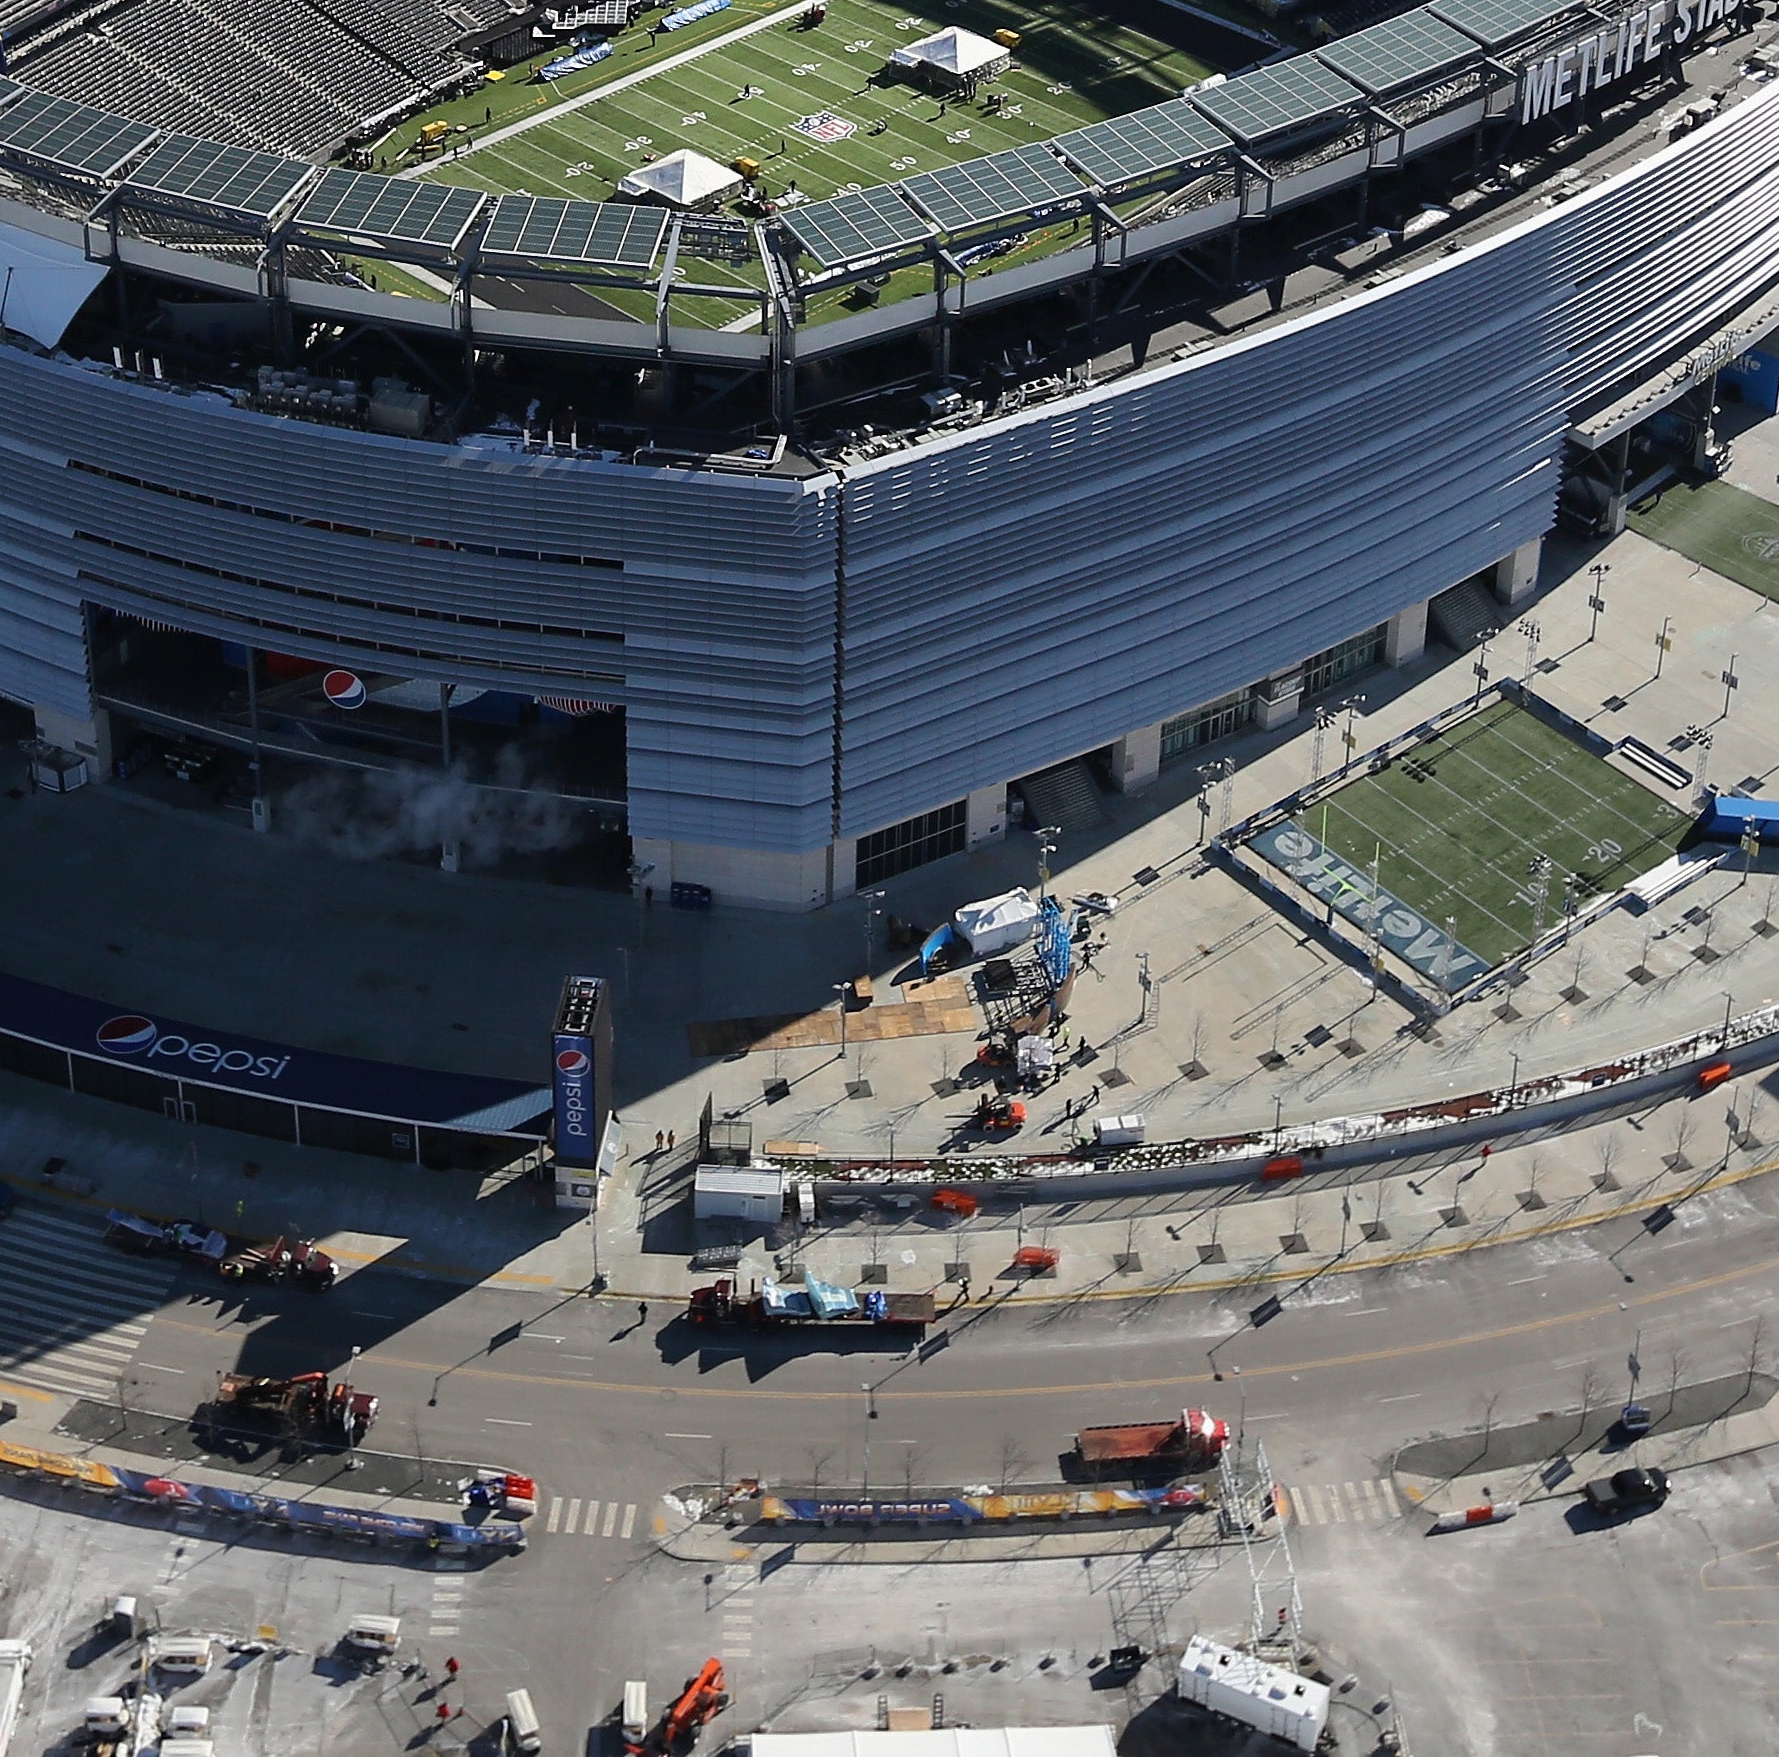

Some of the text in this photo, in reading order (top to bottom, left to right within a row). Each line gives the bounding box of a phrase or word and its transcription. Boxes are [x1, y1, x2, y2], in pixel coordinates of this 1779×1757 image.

[1522, 0, 1666, 126] METLIFE
[819, 120, 849, 140] NFL
[889, 156, 918, 172] 50
[1590, 838, 1623, 864] 20
[1274, 830, 1477, 978] MetLife
[146, 1035, 292, 1080] pepsi
[562, 1081, 588, 1137] pepsi
